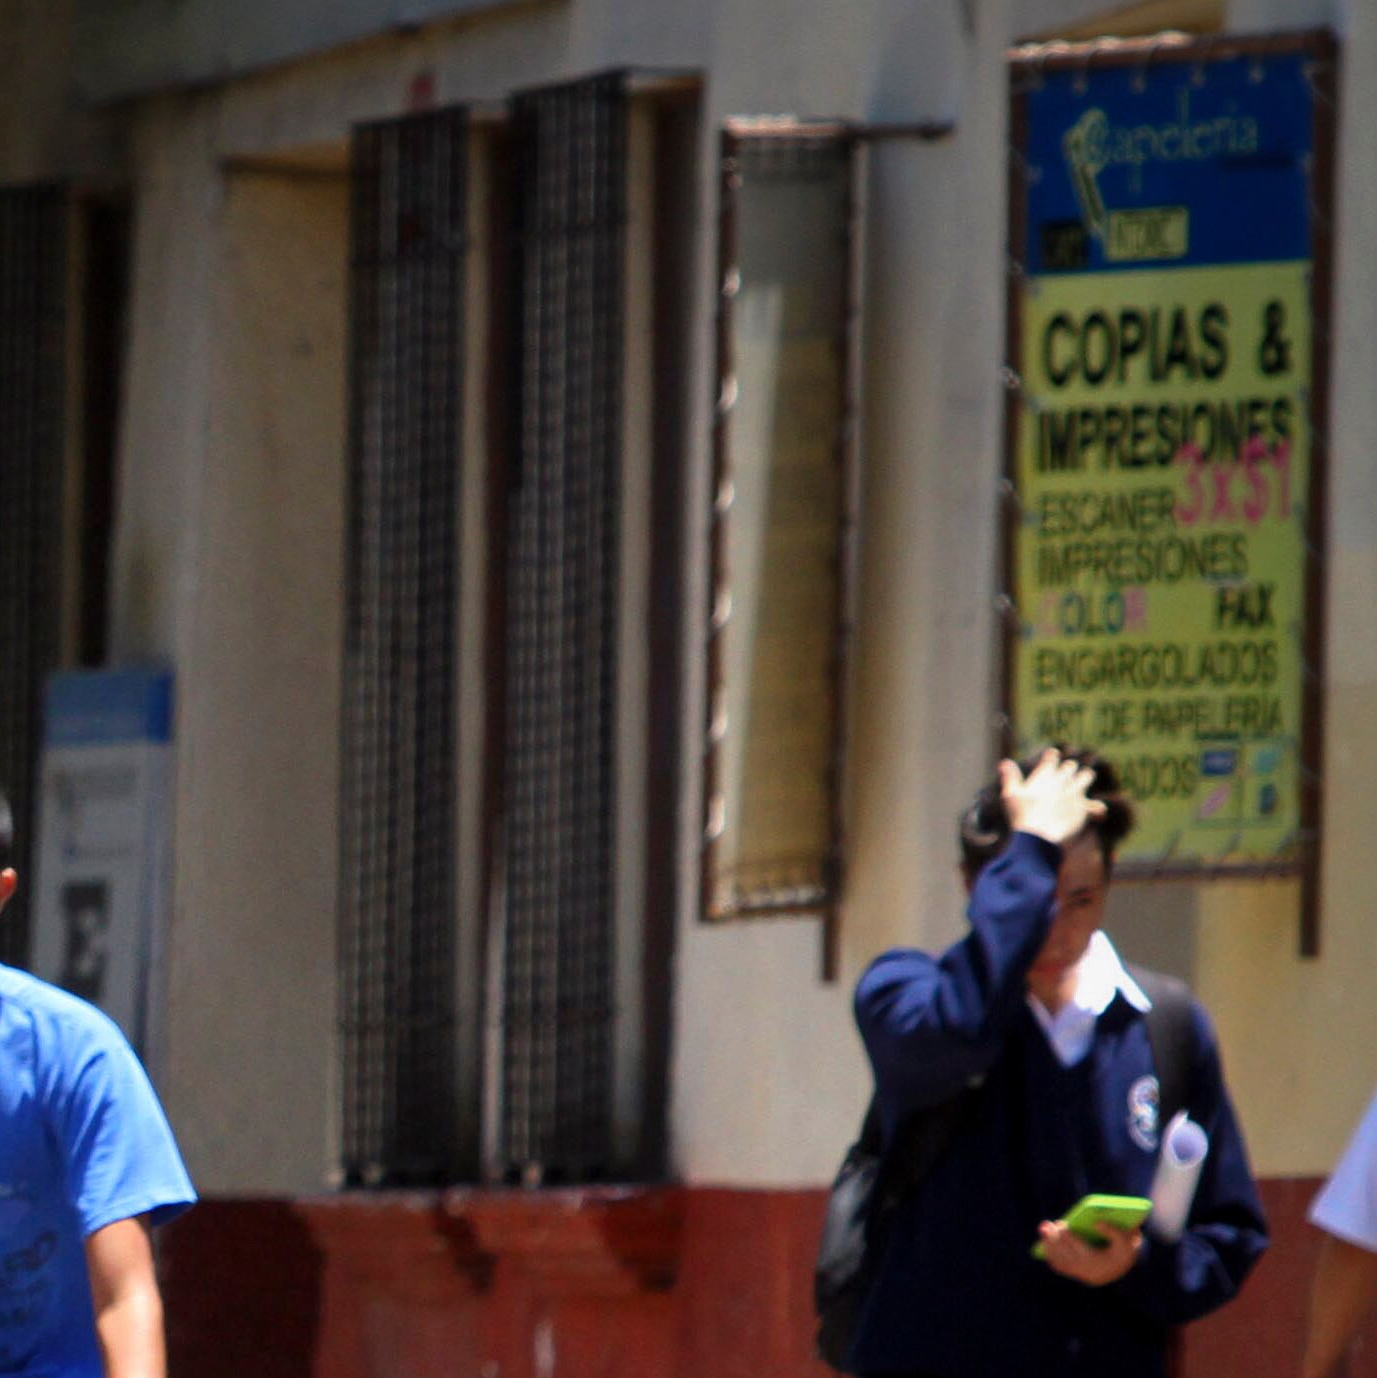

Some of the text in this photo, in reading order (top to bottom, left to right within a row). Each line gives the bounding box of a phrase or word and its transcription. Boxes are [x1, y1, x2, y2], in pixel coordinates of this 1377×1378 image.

[1043, 299, 1291, 389] COPIAS &
[1036, 398, 1292, 472] IMPRESIONES
[1036, 488, 1177, 538] ESCANER
[1036, 532, 1249, 587] IMPRESIONES
[1040, 583, 1275, 638] COLOR FAX
[1033, 640, 1281, 694] ENGARGOLADOS
[1097, 700, 1131, 740] DE
